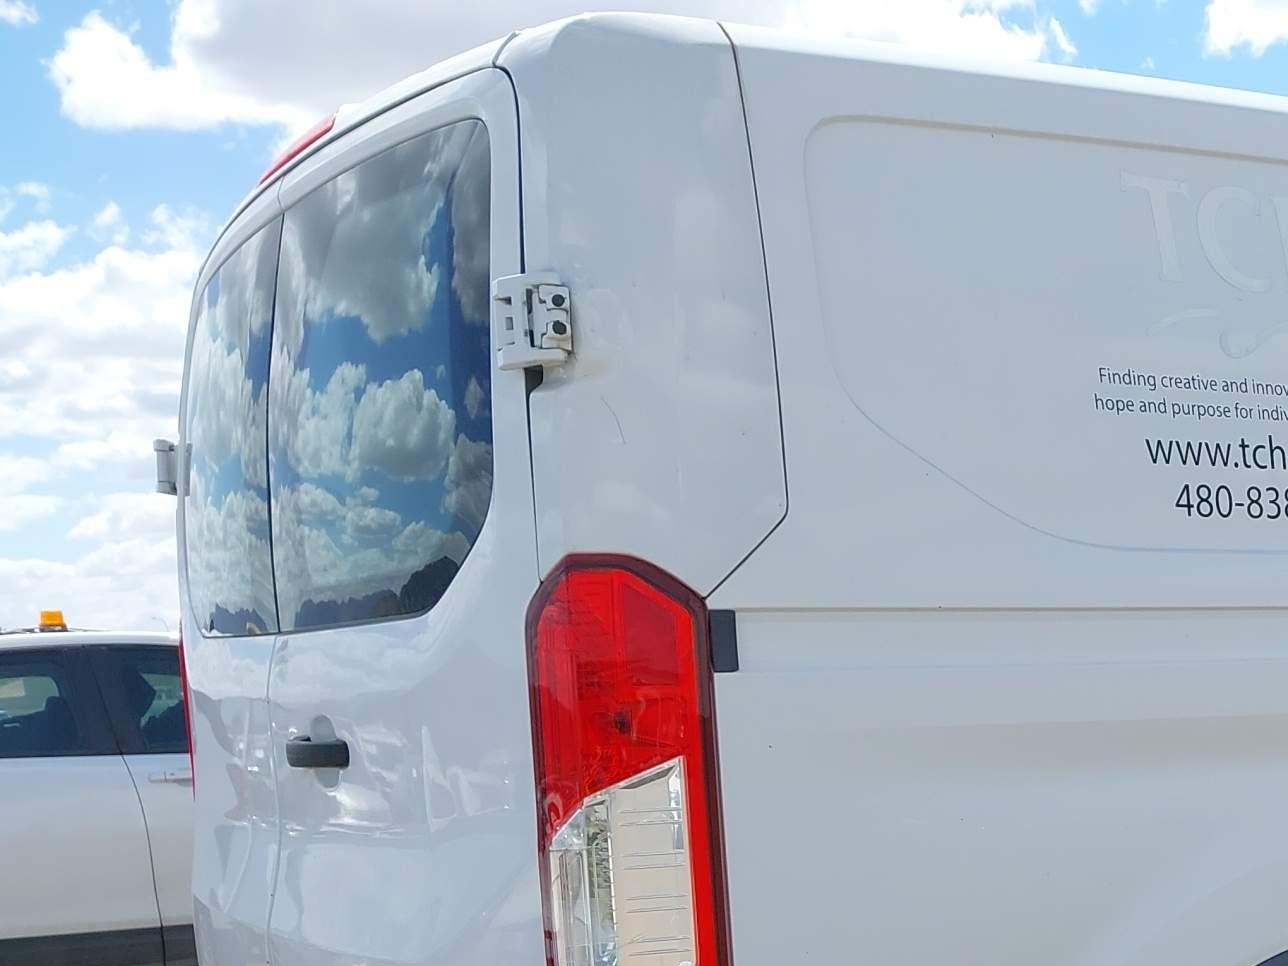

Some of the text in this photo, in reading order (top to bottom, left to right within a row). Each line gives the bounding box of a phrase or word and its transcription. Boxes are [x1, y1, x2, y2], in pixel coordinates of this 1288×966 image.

[1098, 367, 1157, 392] Finding
[1160, 374, 1218, 392] creative
[1221, 377, 1249, 394] and
[1094, 392, 1135, 416] hope
[1138, 397, 1168, 415] and
[1171, 402, 1232, 421] purpose
[1233, 401, 1254, 420] for
